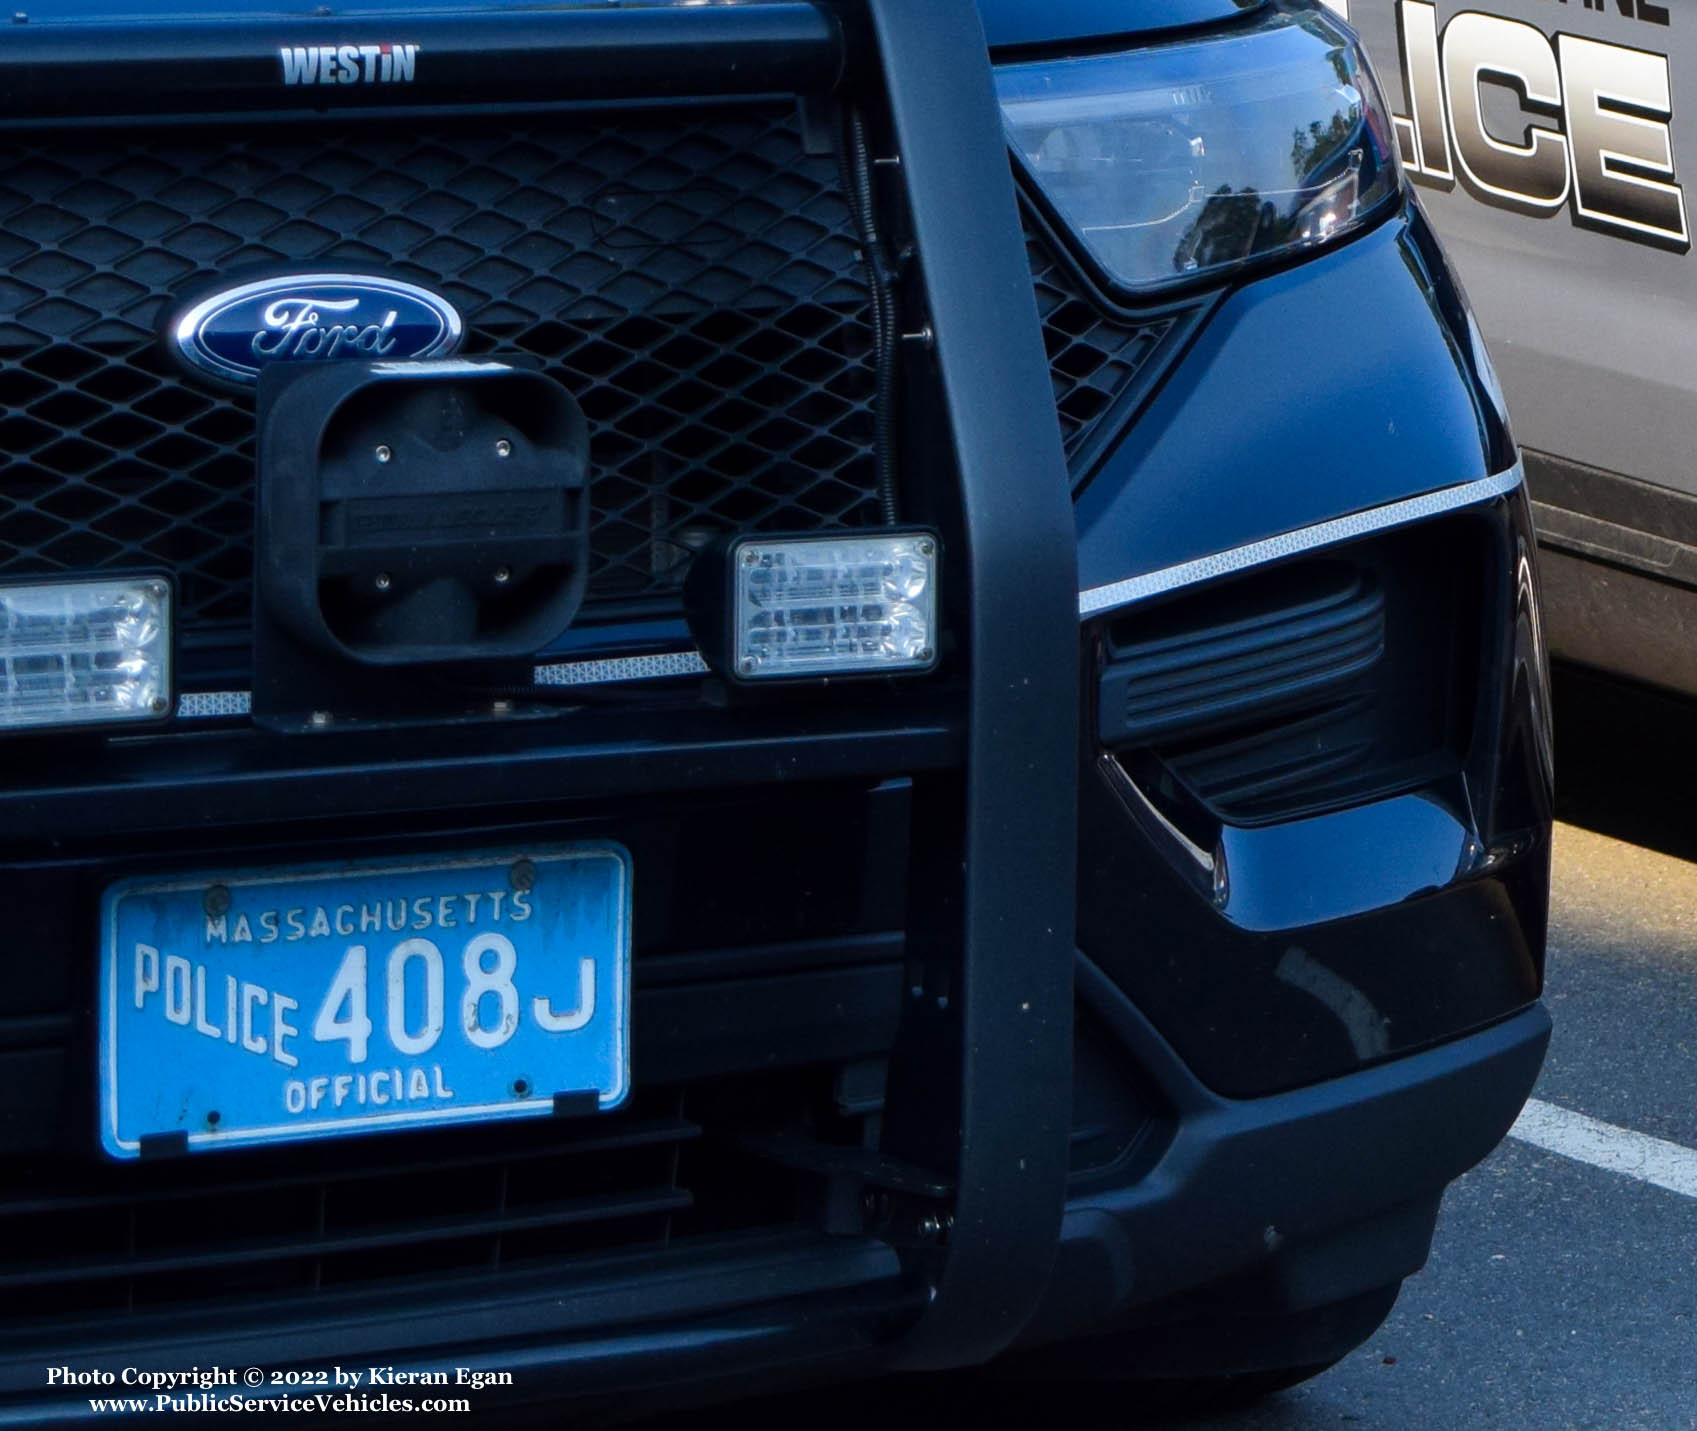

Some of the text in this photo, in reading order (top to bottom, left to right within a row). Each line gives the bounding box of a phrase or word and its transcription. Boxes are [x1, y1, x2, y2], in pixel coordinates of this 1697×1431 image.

[251, 297, 398, 358] Ford
[205, 889, 532, 944] MASSACHUSETTS
[135, 943, 299, 1067] POLICE
[285, 1067, 454, 1114] OFFICIAL
